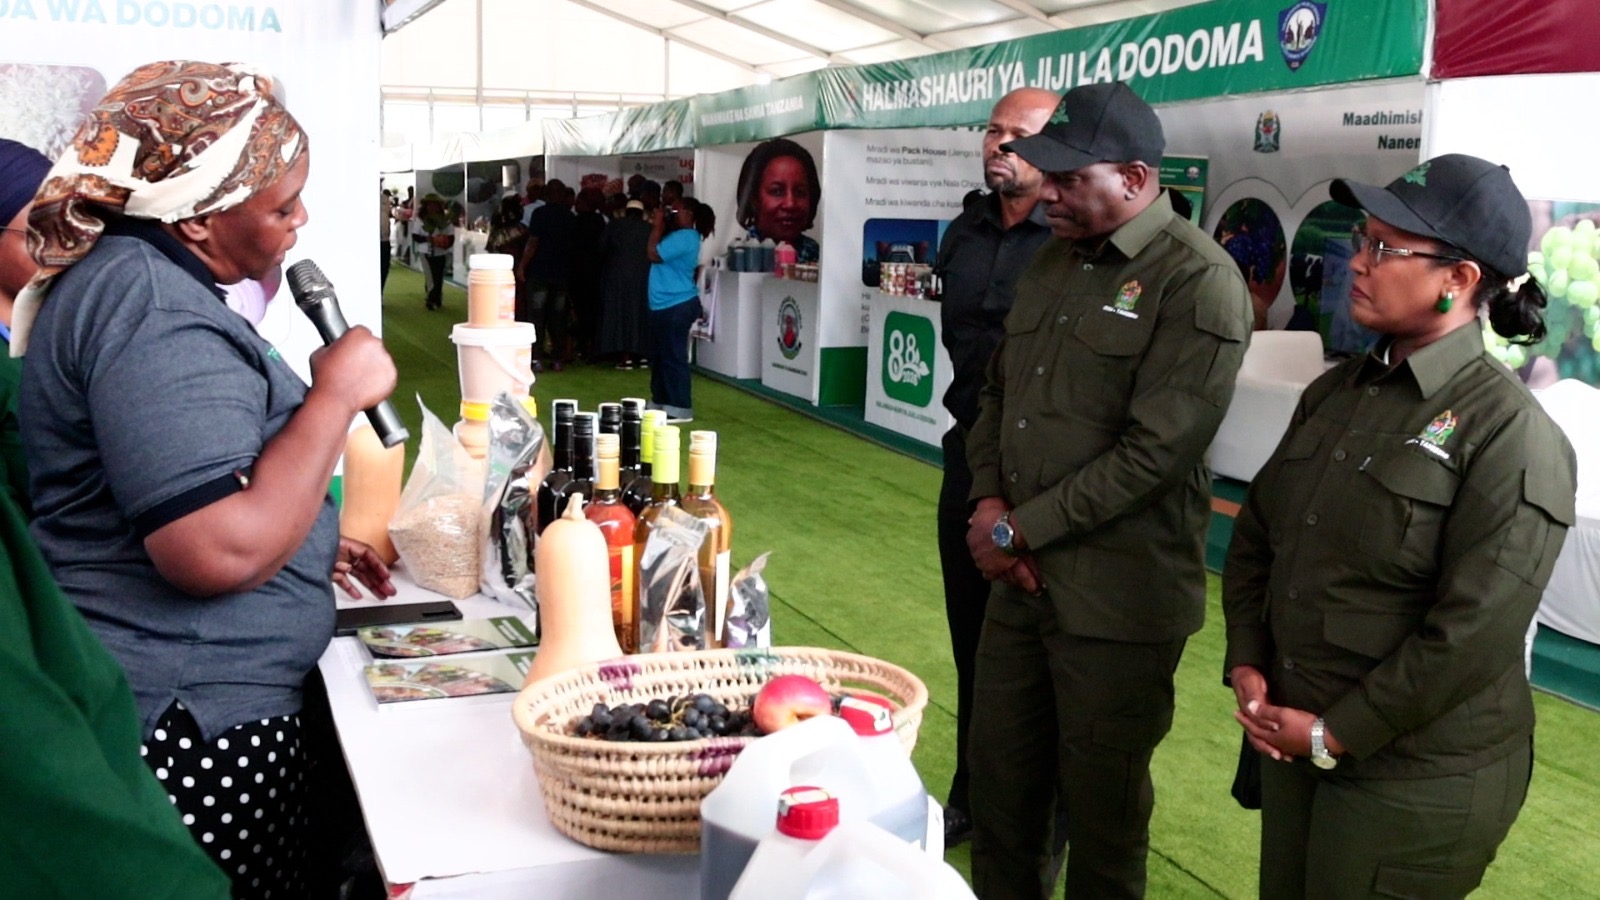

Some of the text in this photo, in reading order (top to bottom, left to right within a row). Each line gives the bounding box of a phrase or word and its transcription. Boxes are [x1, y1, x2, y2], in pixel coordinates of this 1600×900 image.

[48, 0, 107, 24] WA
[116, 0, 283, 33] DODOMA
[863, 66, 994, 112] HALMASHAURI
[998, 61, 1026, 96] YA
[1030, 52, 1074, 91] JIJI
[1077, 47, 1113, 86] LA
[1118, 19, 1264, 82] DODOMA
[866, 145, 888, 154] Mradi
[901, 146, 921, 155] Pack
[922, 147, 947, 156] House
[865, 176, 887, 185] Mradi
[865, 198, 886, 206] Mradi
